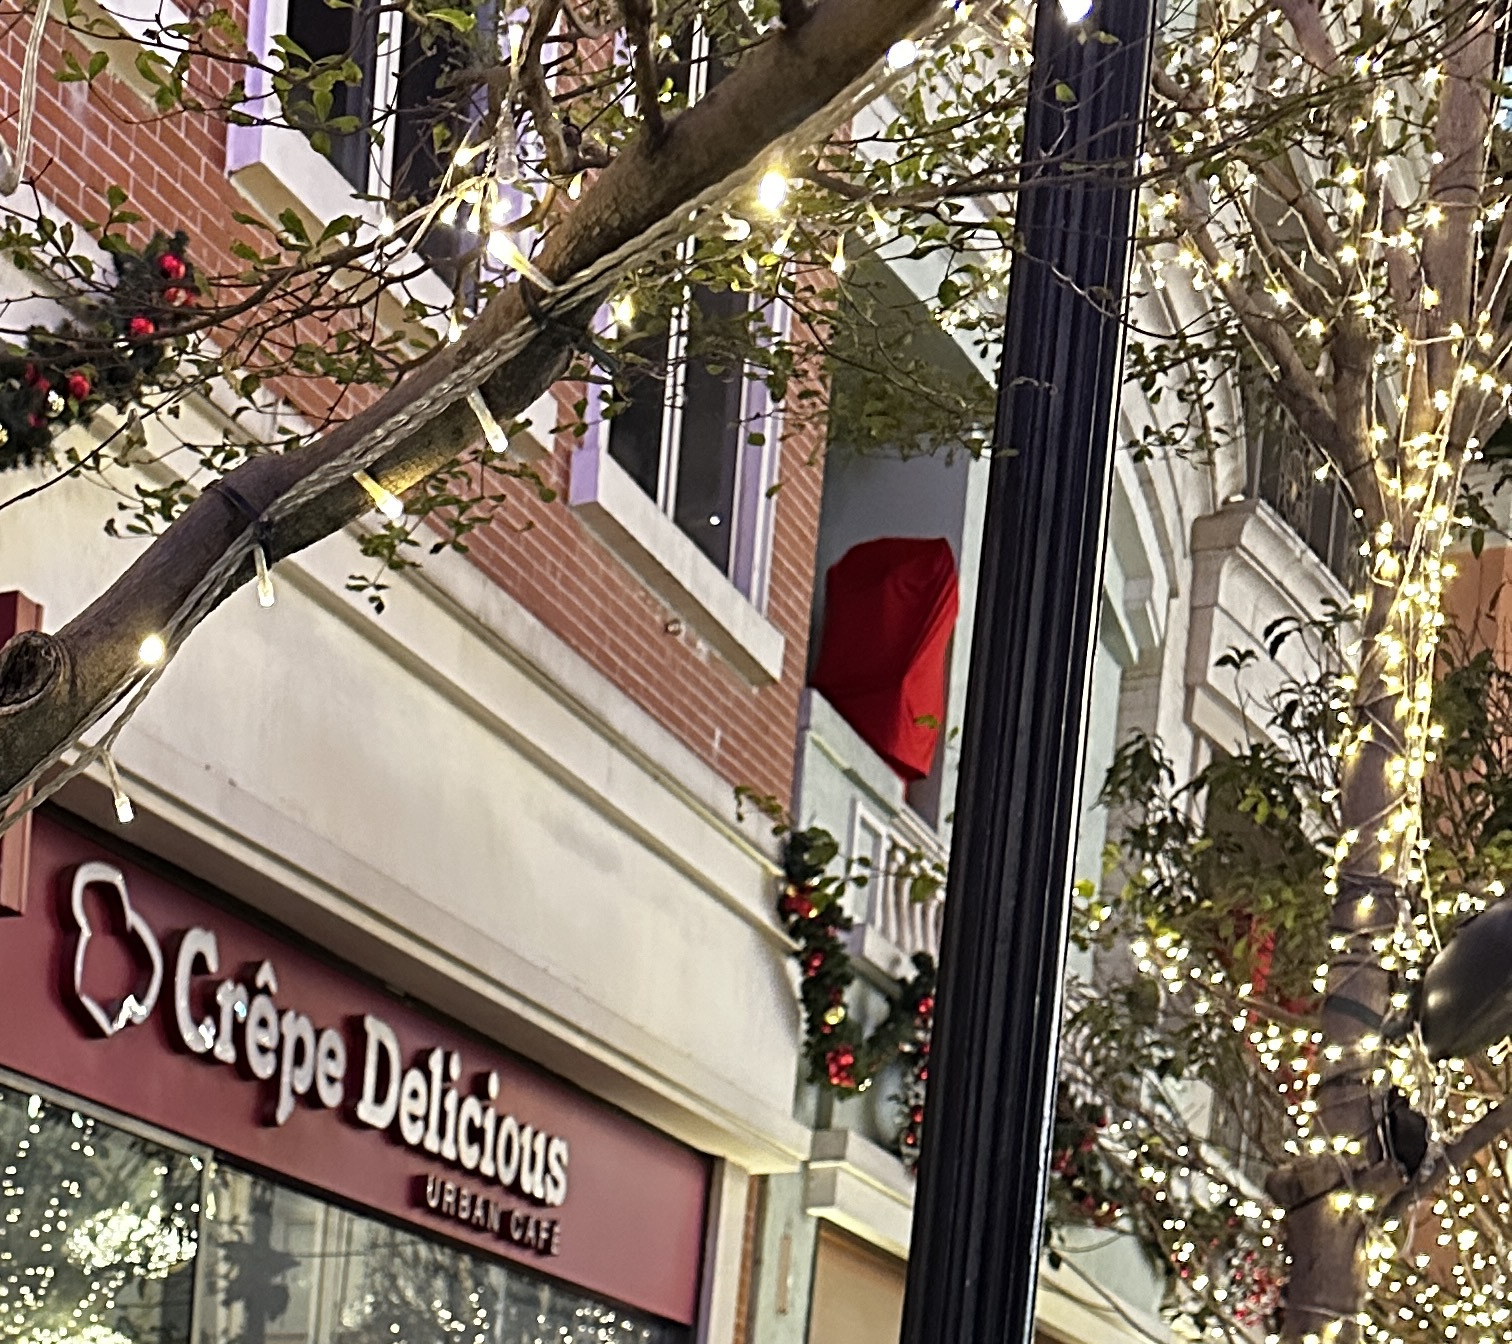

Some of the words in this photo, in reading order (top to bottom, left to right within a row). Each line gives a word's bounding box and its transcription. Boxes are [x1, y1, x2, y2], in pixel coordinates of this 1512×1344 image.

[174, 926, 345, 1127] Crêpe
[356, 1014, 570, 1207] Delicious
[426, 1174, 500, 1233] URBAN
